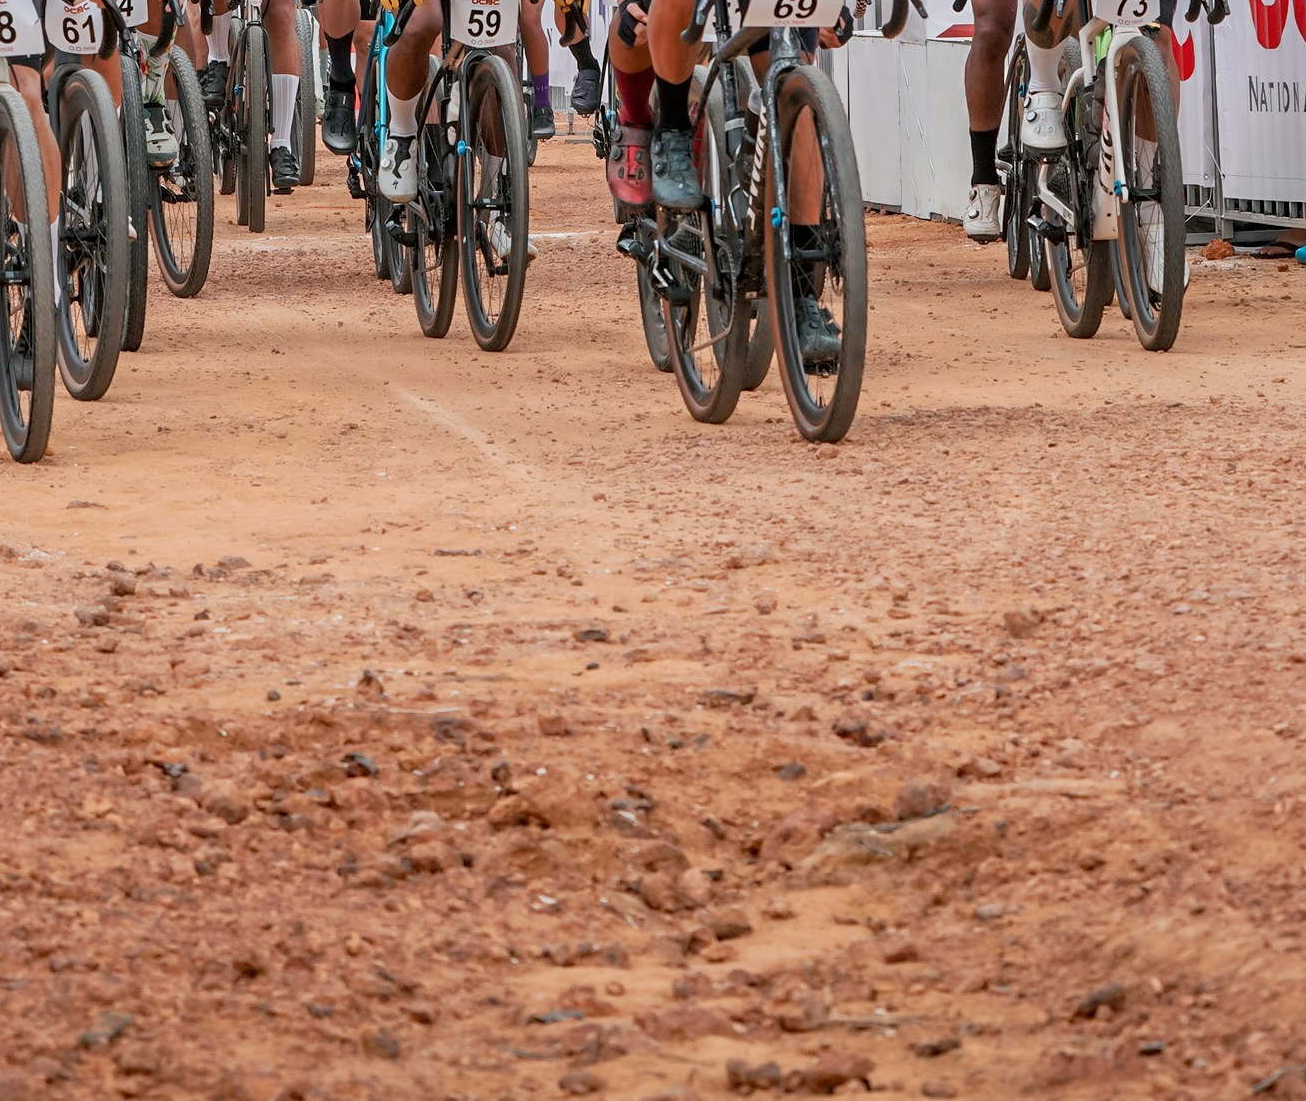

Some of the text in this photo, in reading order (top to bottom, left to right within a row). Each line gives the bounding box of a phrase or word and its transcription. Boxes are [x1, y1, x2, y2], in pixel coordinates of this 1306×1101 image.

[63, 1, 90, 14] OCBC
[62, 14, 96, 44] 61
[467, 9, 501, 38] 59
